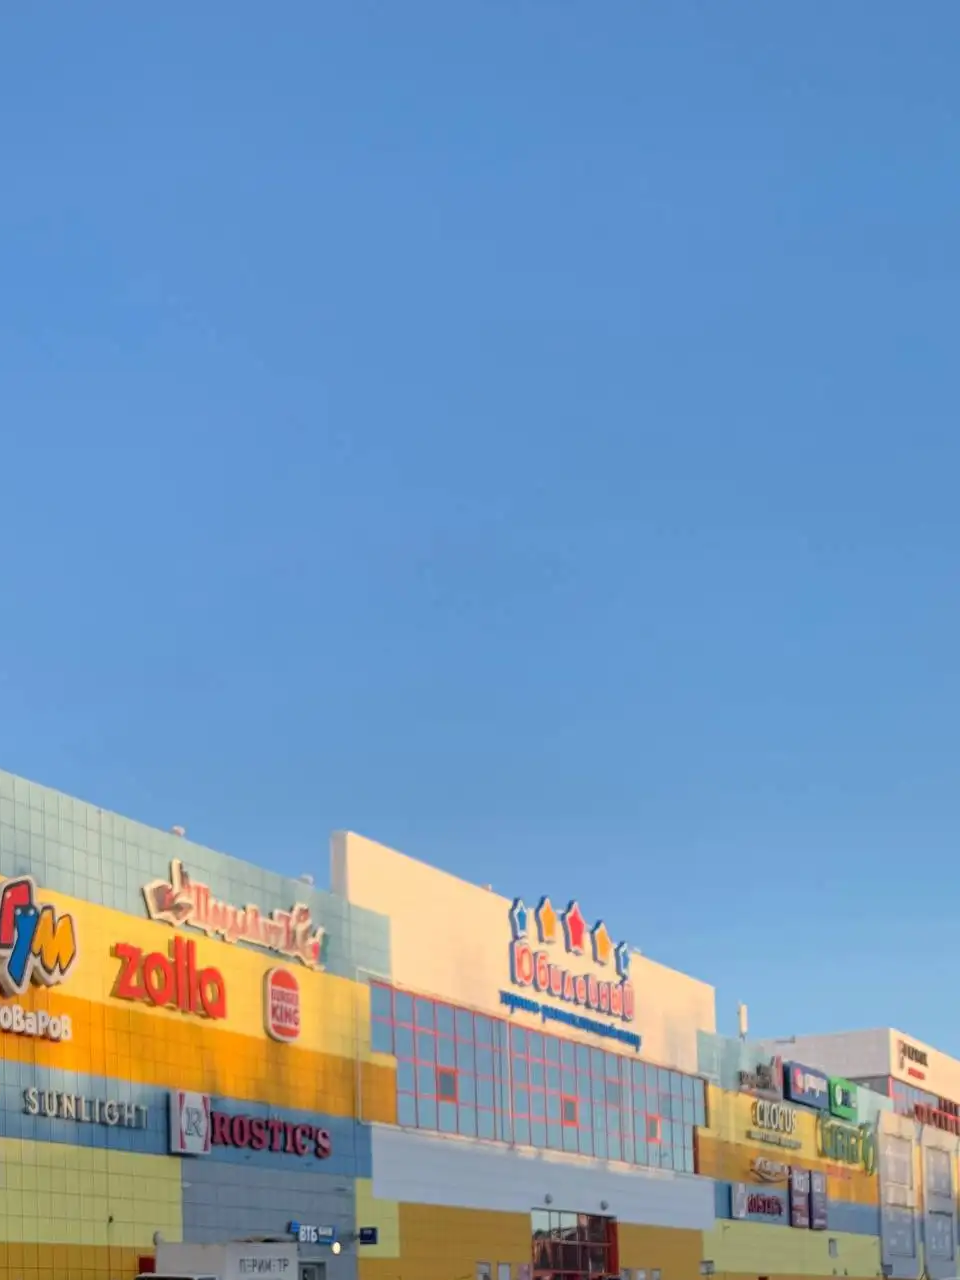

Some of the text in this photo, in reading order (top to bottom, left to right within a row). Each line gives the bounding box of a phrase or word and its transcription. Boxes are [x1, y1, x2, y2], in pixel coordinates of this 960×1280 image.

[115, 935, 227, 1020] zolla
[271, 1002, 300, 1028] KING
[24, 1086, 148, 1129] SUNLIGHT
[211, 1111, 332, 1158] ROSTIC'S
[299, 1224, 318, 1243] ВТБ
